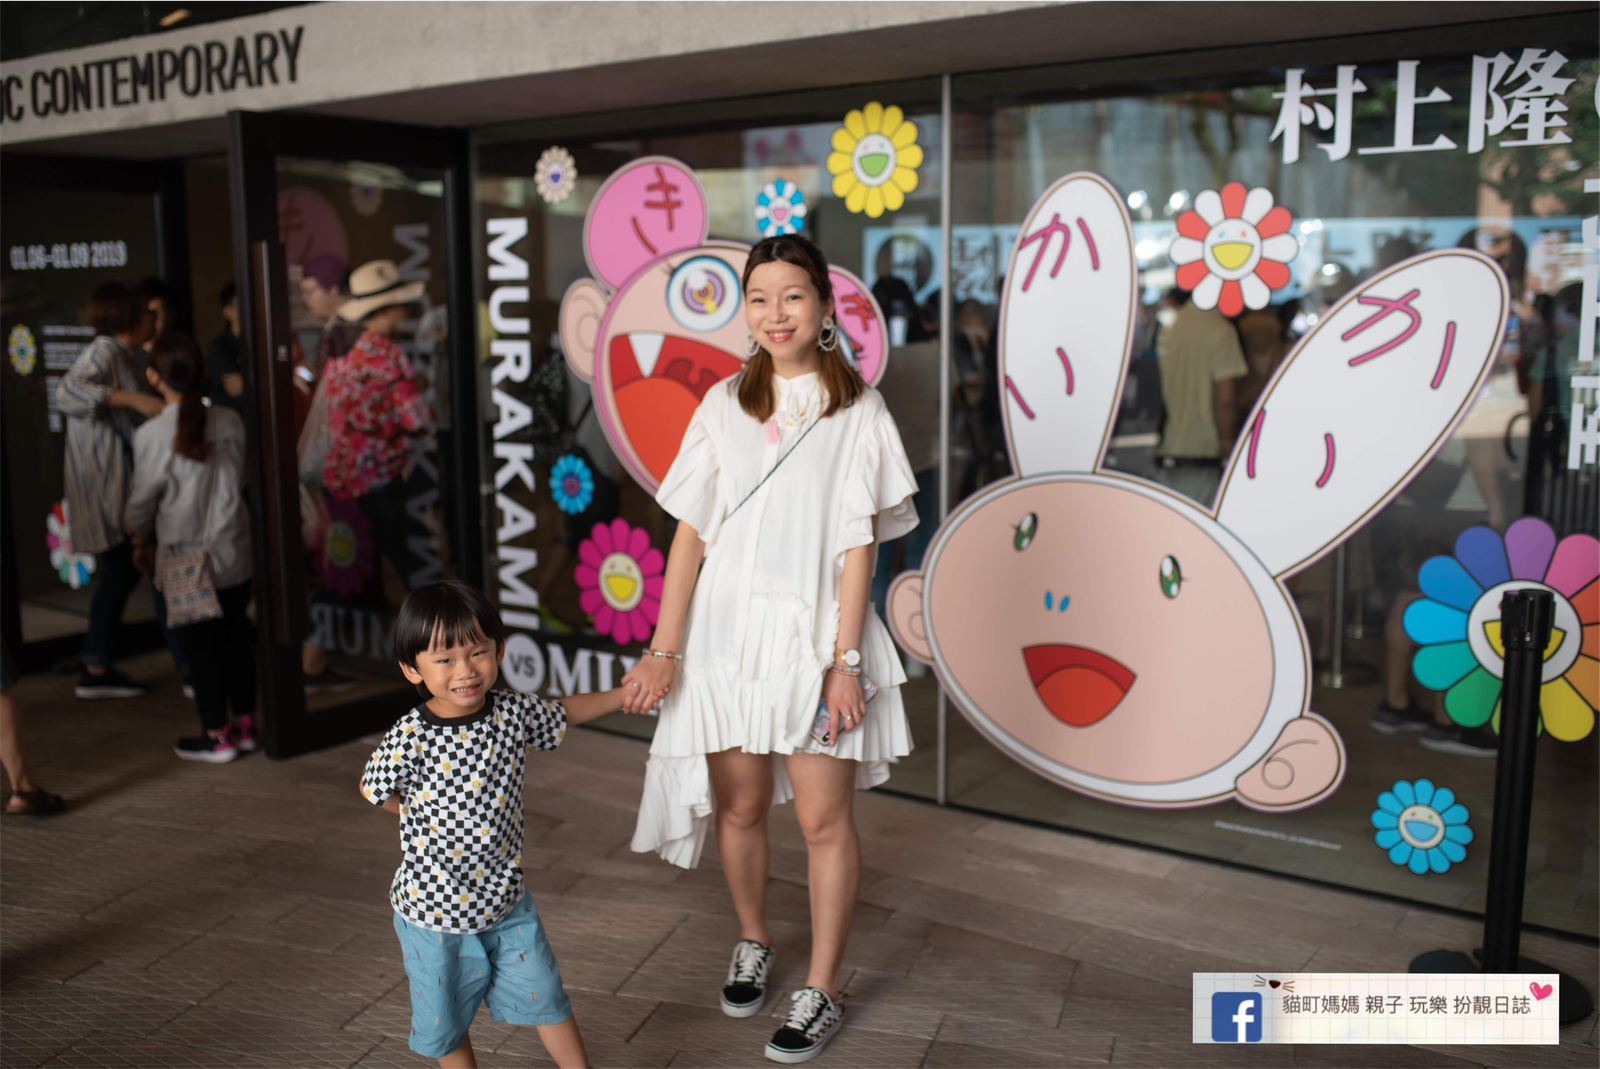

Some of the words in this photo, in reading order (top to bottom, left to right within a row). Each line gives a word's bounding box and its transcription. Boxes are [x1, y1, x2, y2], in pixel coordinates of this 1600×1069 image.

[30, 25, 305, 119] CONTEMPORARY
[1268, 47, 1577, 165] 村上隆
[486, 216, 541, 632] MURAKAMI
